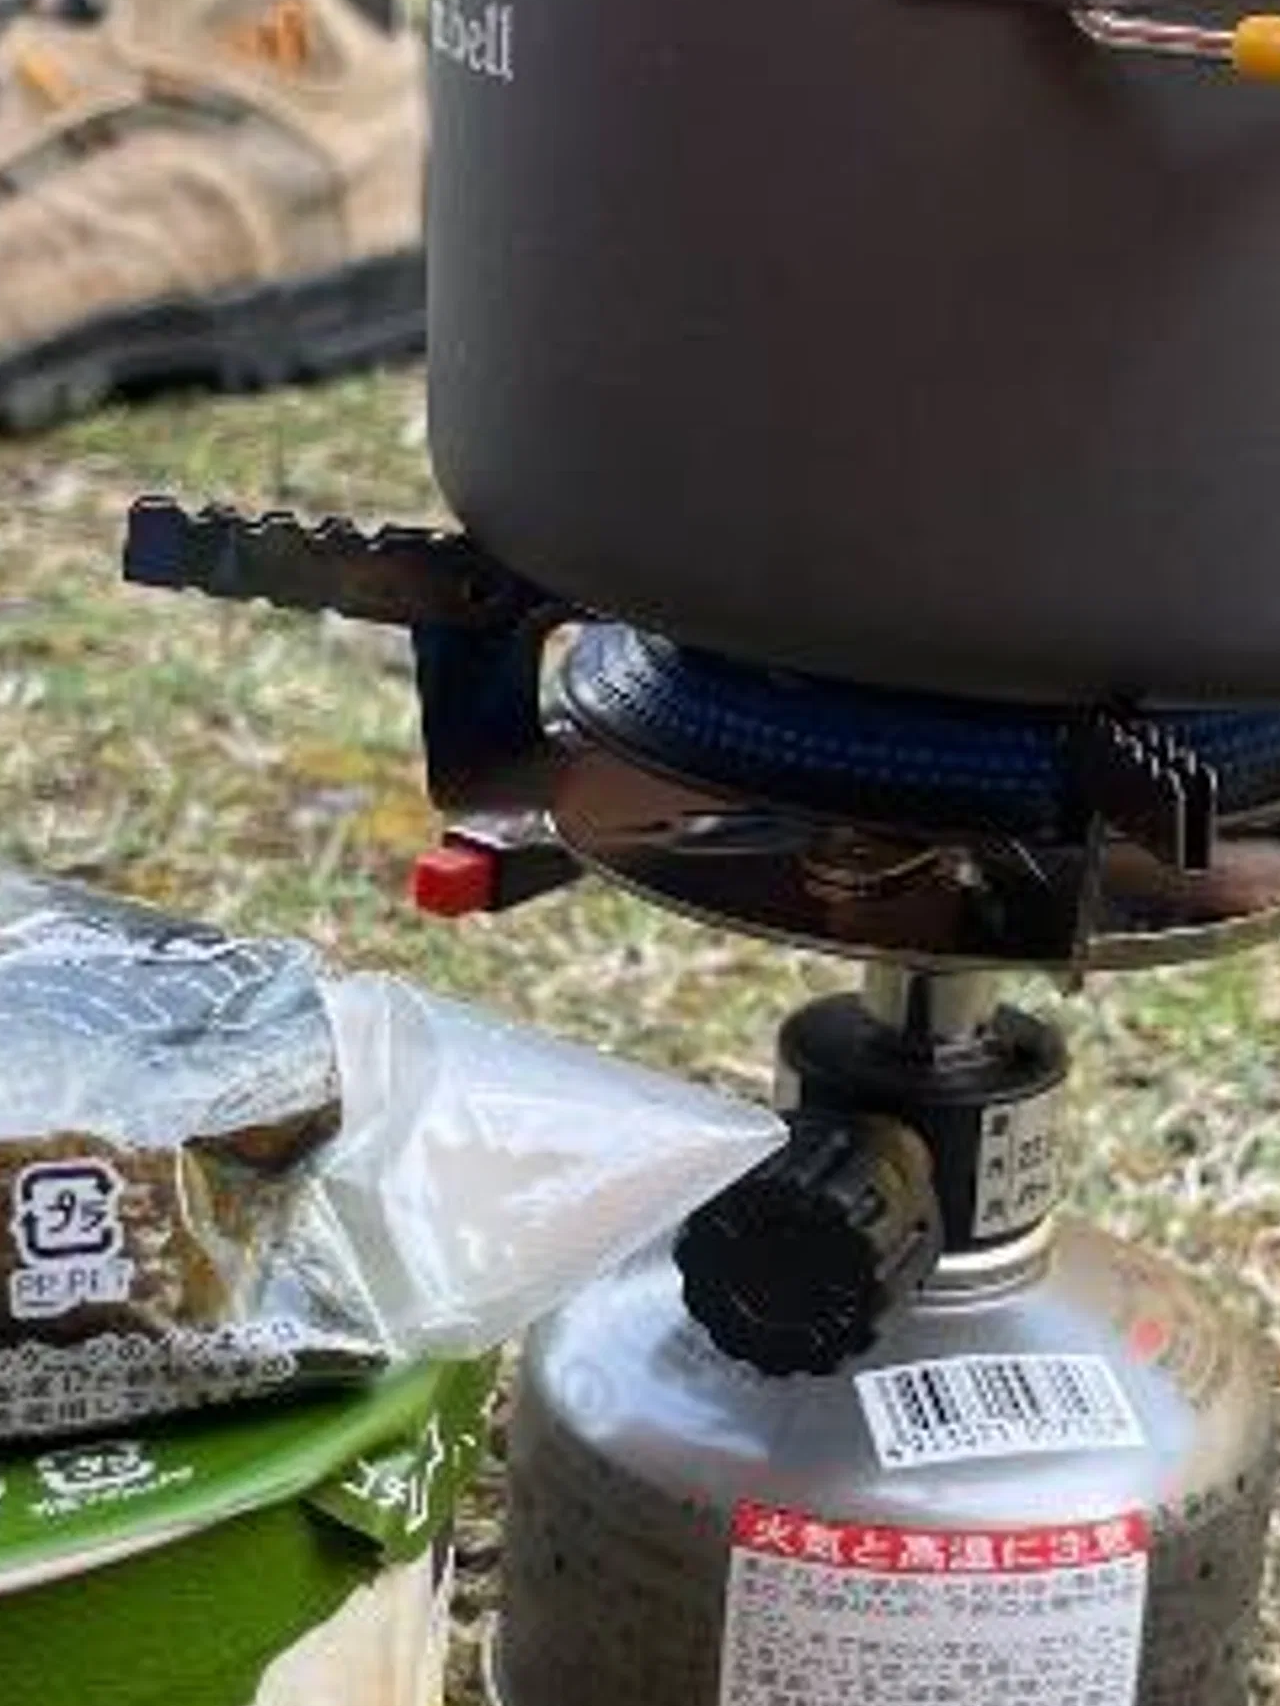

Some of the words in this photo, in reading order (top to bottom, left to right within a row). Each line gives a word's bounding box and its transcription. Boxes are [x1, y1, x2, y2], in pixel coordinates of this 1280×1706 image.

[752, 1515, 1134, 1569] 火気と高温に注意
